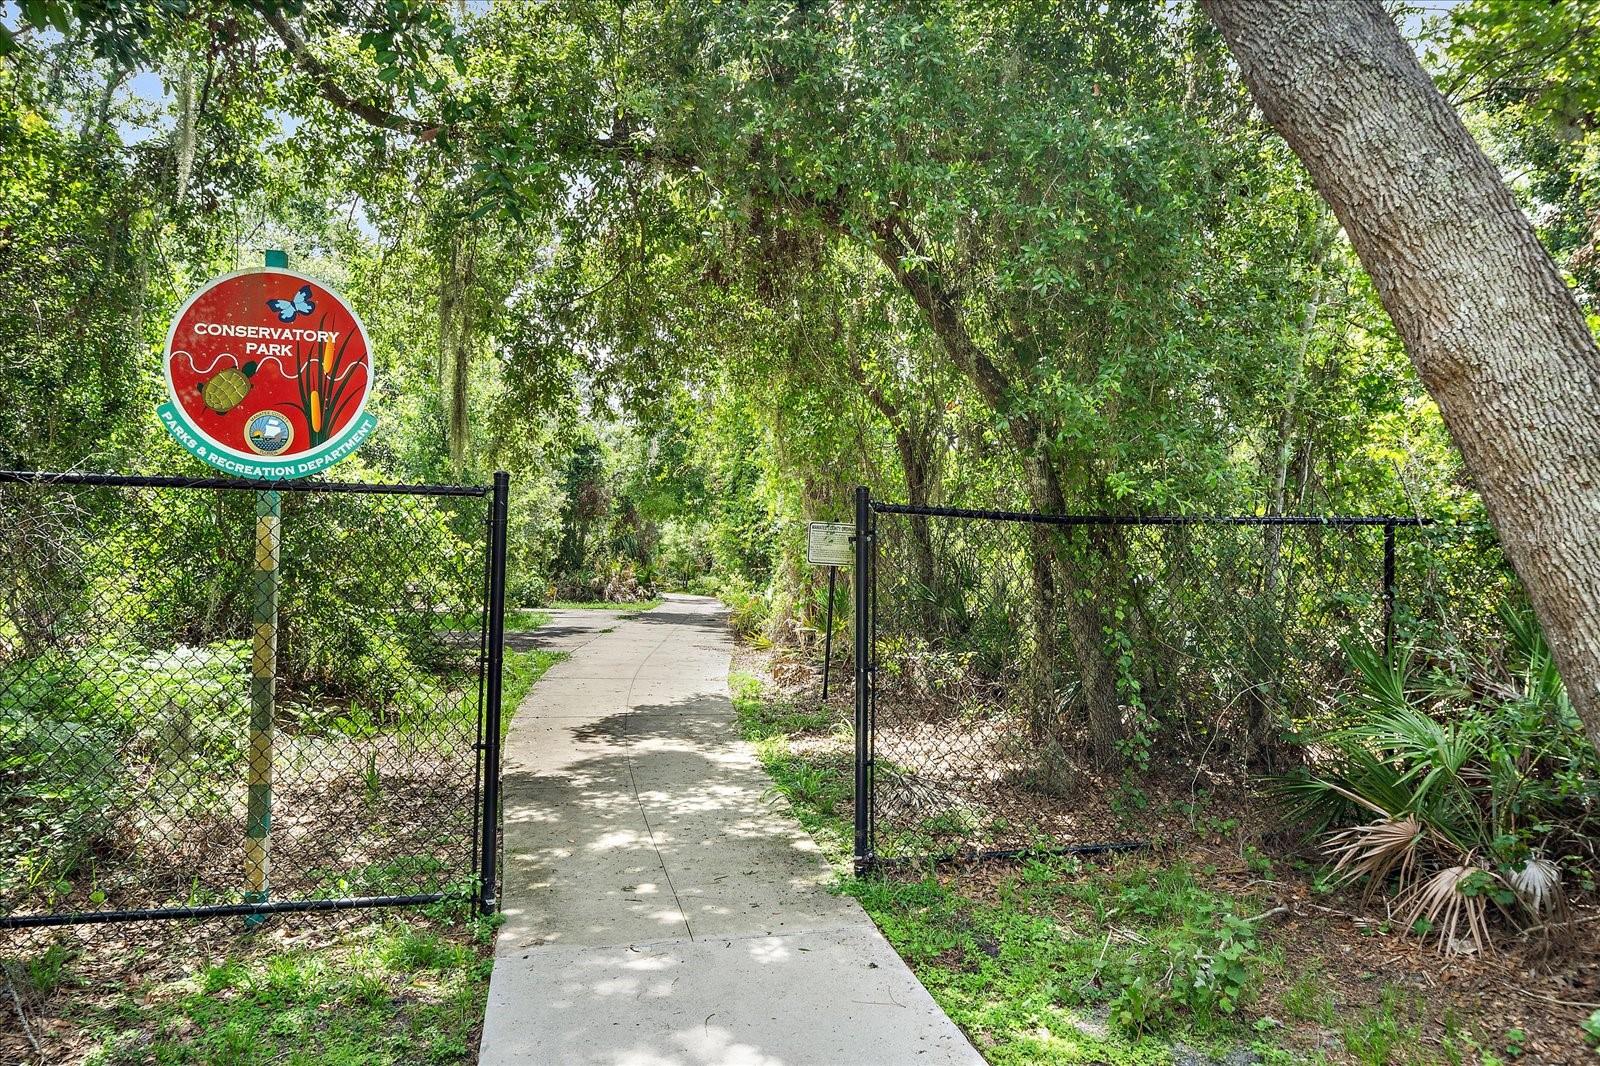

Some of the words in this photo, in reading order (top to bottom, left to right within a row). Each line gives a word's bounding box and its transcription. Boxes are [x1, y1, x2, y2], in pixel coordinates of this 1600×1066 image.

[194, 323, 340, 343] CONSERVATORY
[246, 342, 293, 356] PARK
[161, 411, 199, 449] PARKS
[196, 445, 207, 456] &
[210, 453, 295, 476] RECREATION
[297, 419, 375, 472] DEPARTMENT
